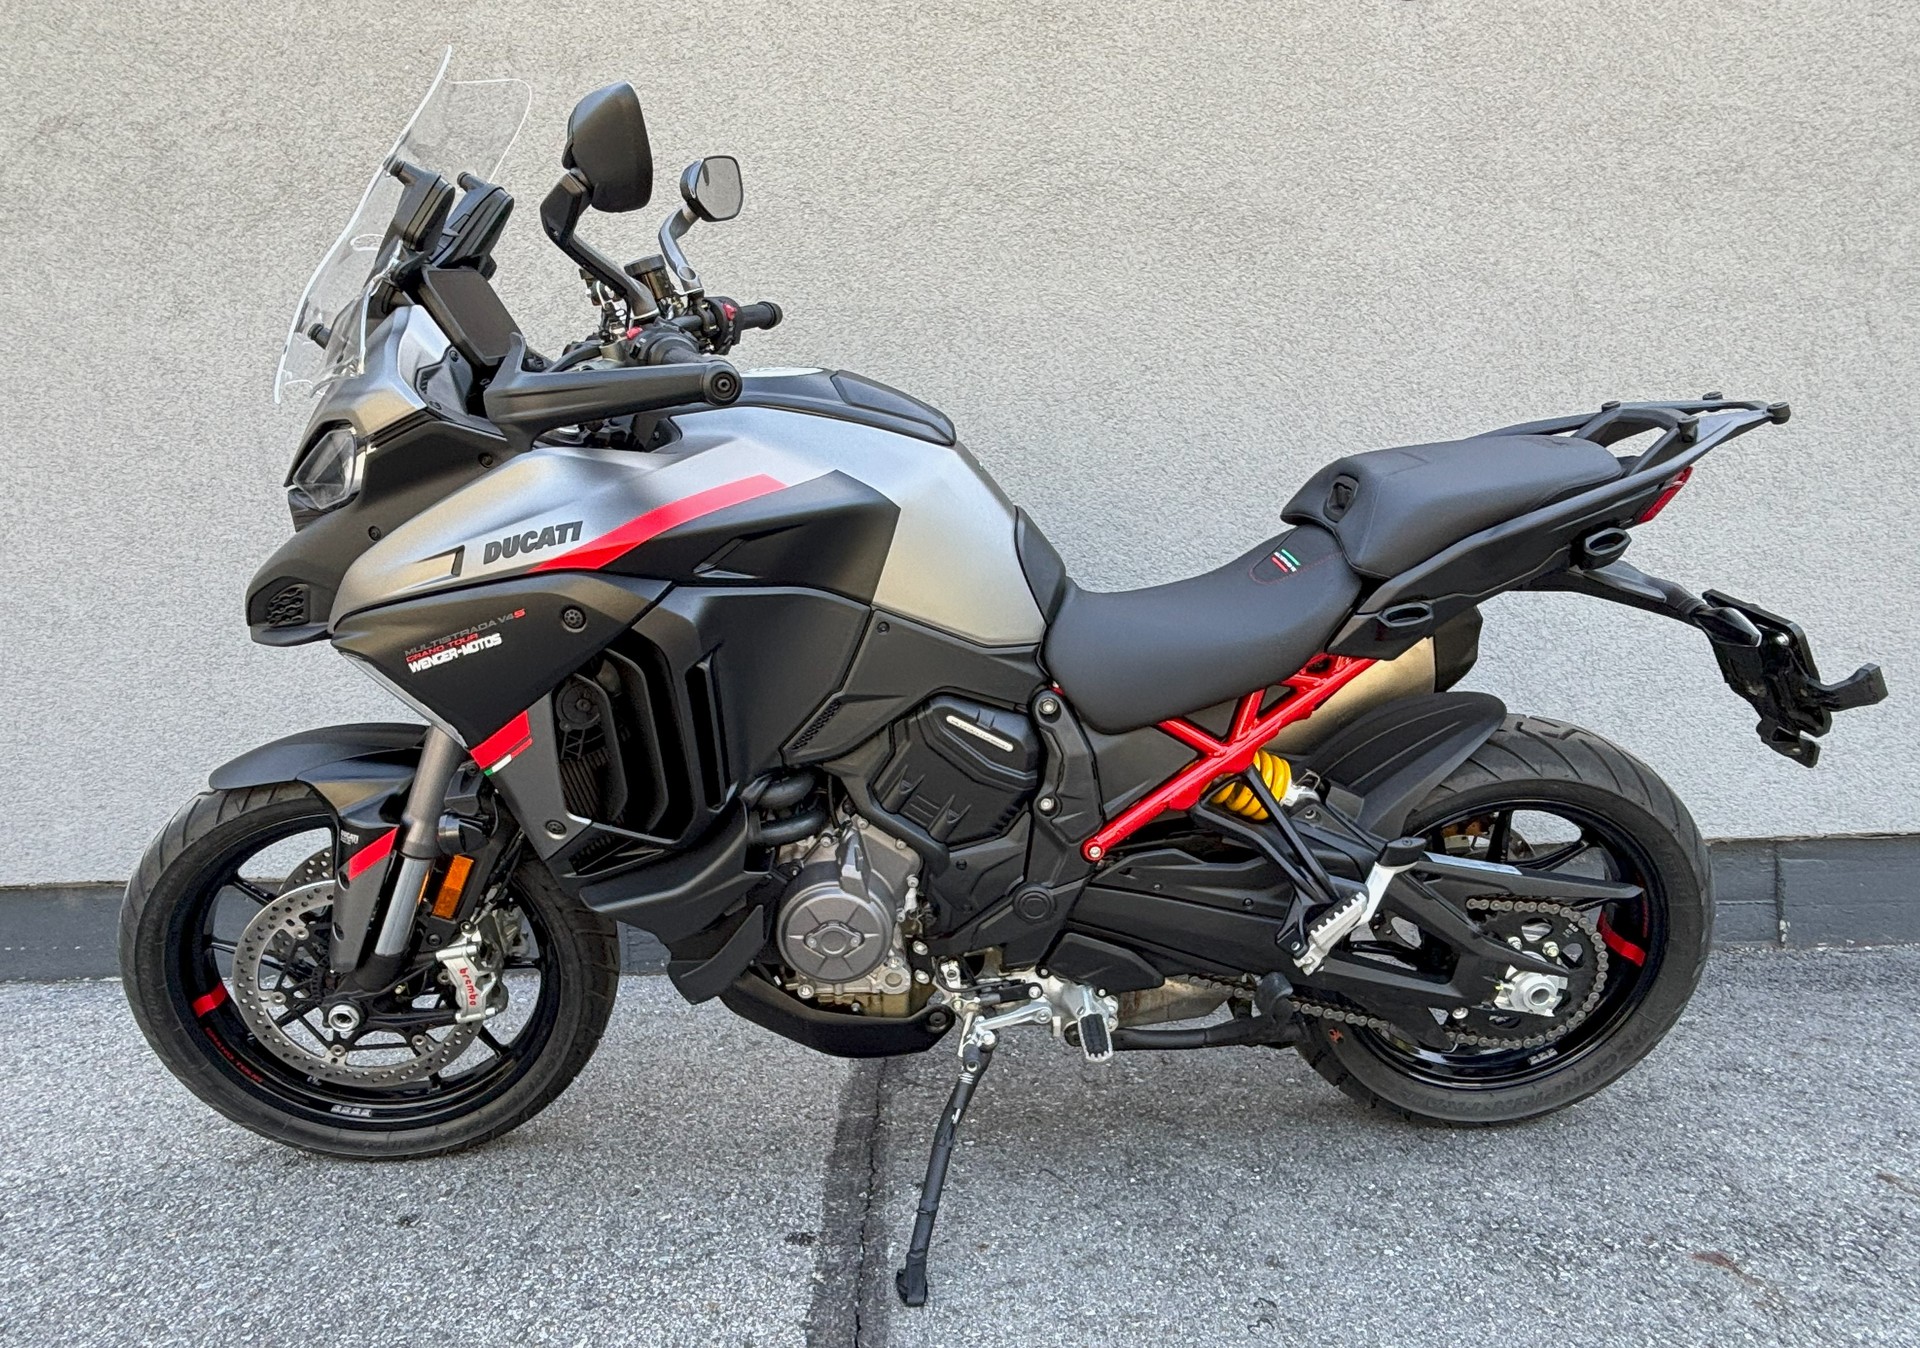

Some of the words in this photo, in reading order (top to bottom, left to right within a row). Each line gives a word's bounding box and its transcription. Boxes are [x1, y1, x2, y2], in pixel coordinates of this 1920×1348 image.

[484, 521, 583, 564] DUCATI
[405, 620, 496, 656] MULTISTRADA
[497, 608, 525, 623] V4S
[406, 645, 444, 663] GRAND
[447, 633, 479, 647] TOUR
[408, 633, 502, 673] WENGER-MOTOS
[459, 967, 479, 1006] brembo
